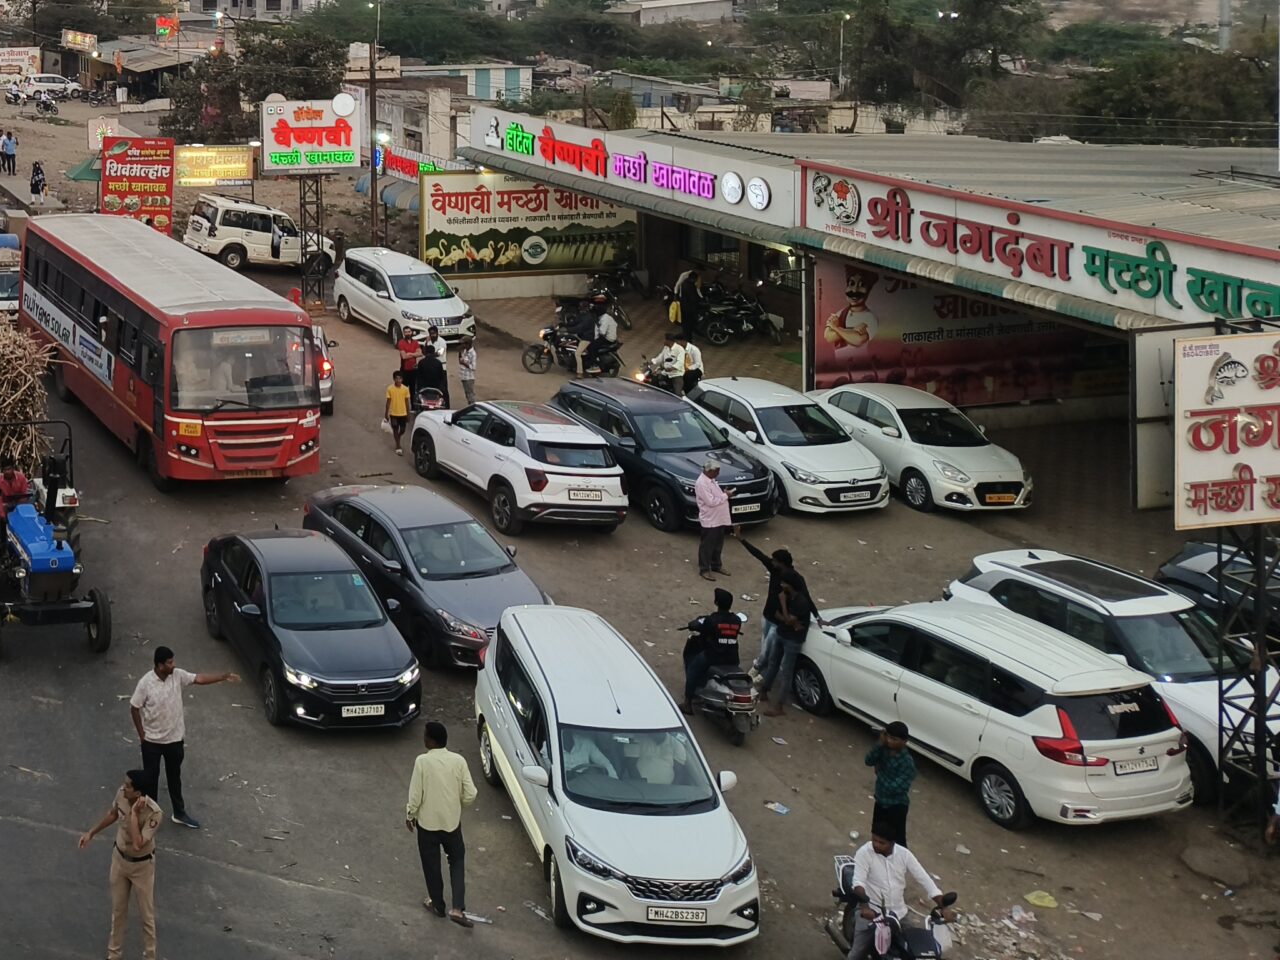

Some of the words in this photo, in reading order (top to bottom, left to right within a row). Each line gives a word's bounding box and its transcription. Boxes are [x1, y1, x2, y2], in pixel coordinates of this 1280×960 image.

[271, 118, 352, 147] वैष्णवी
[106, 158, 171, 180] शिवमल्हार
[269, 147, 301, 165] मच्छी
[304, 150, 355, 165] खानावळ
[505, 122, 534, 155] हॉटेल
[538, 125, 608, 178] वैष्णवी
[612, 150, 648, 183] मच्छी
[651, 161, 717, 199] खानावळ
[431, 182, 492, 215] वैष्णवी
[496, 183, 550, 213] मच्छी
[867, 187, 913, 243] श्री
[920, 212, 1074, 282] जगदंबा
[1082, 241, 1183, 310] मच्छी
[51, 317, 70, 345] SOLAR
[903, 326, 944, 344] शाकाहारी
[1184, 463, 1257, 516] मच्छी
